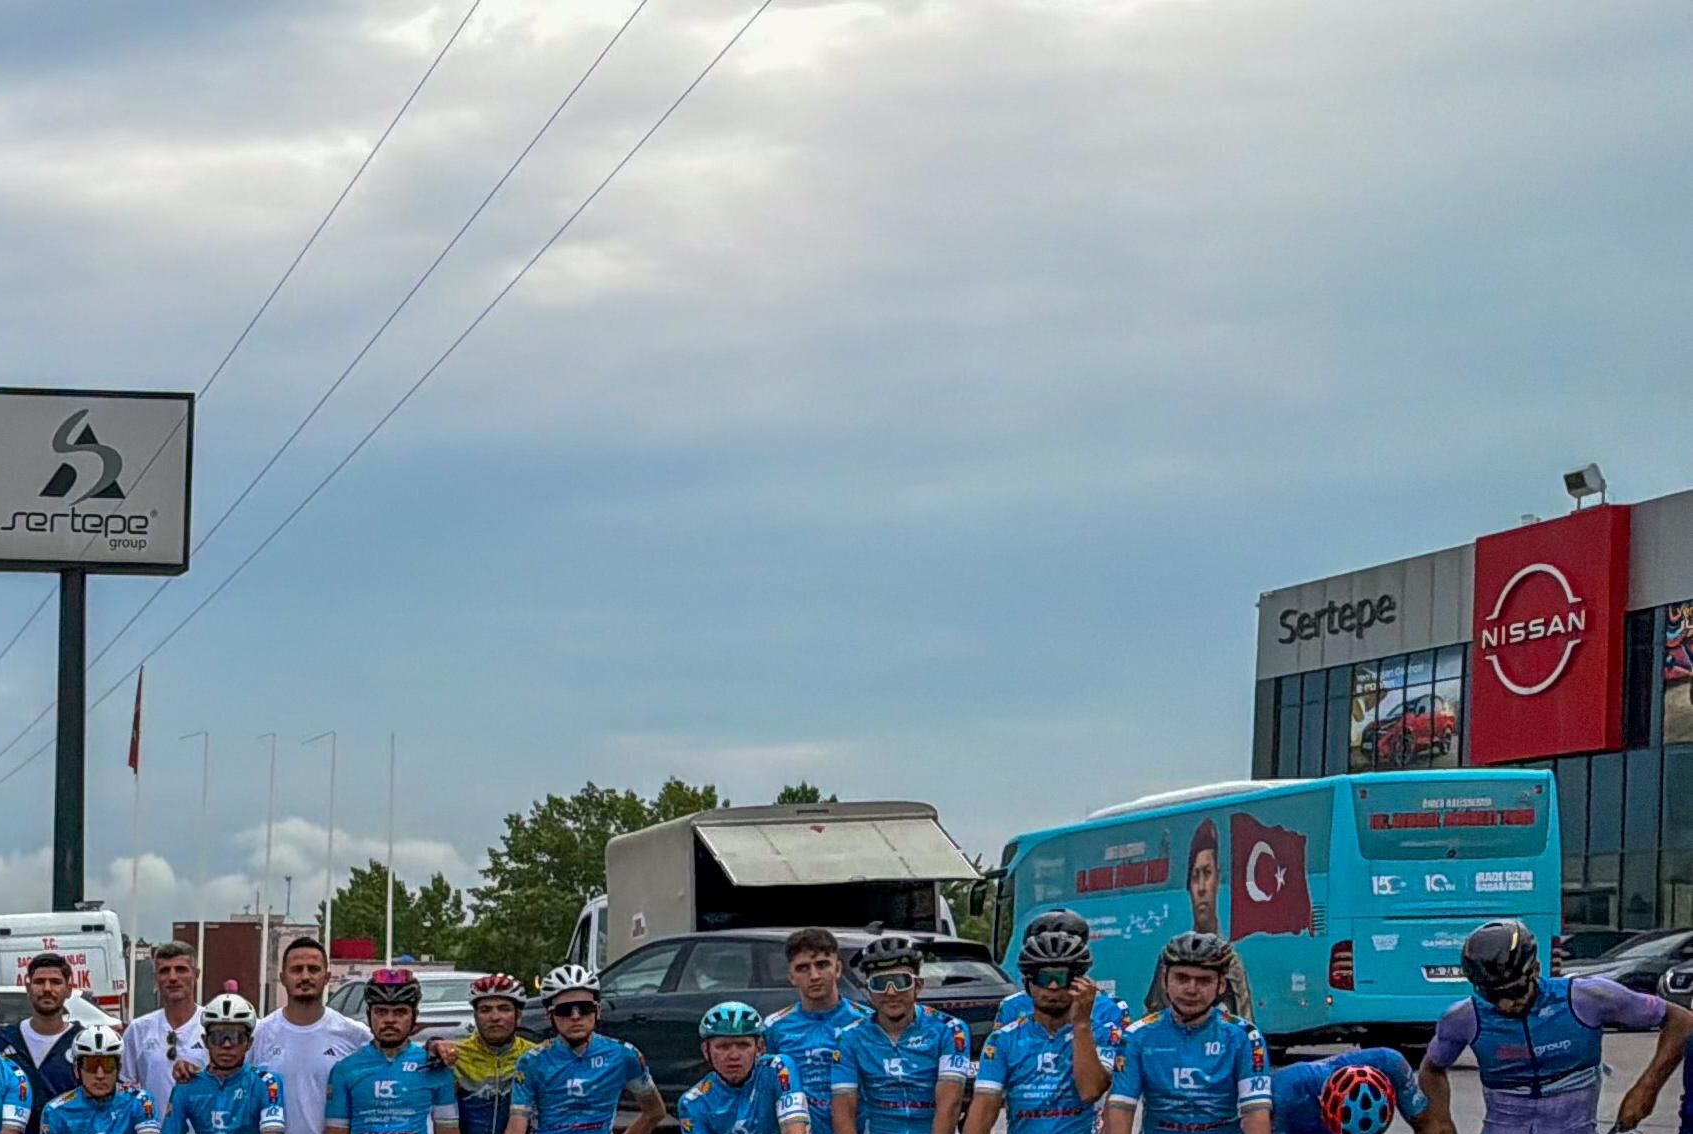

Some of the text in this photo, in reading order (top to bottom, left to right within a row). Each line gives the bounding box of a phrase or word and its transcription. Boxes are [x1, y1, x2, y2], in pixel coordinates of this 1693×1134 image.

[1, 507, 149, 537] sertepe
[109, 538, 147, 551] group
[1278, 594, 1396, 644] Sertepe
[1481, 610, 1586, 650] NISSAN
[1204, 1042, 1220, 1056] 10
[1534, 1040, 1571, 1057] group
[590, 1056, 604, 1068] 10
[883, 1058, 907, 1076] 15
[1172, 1067, 1198, 1089] 15
[374, 1081, 396, 1098] 15
[566, 1078, 589, 1097] 15
